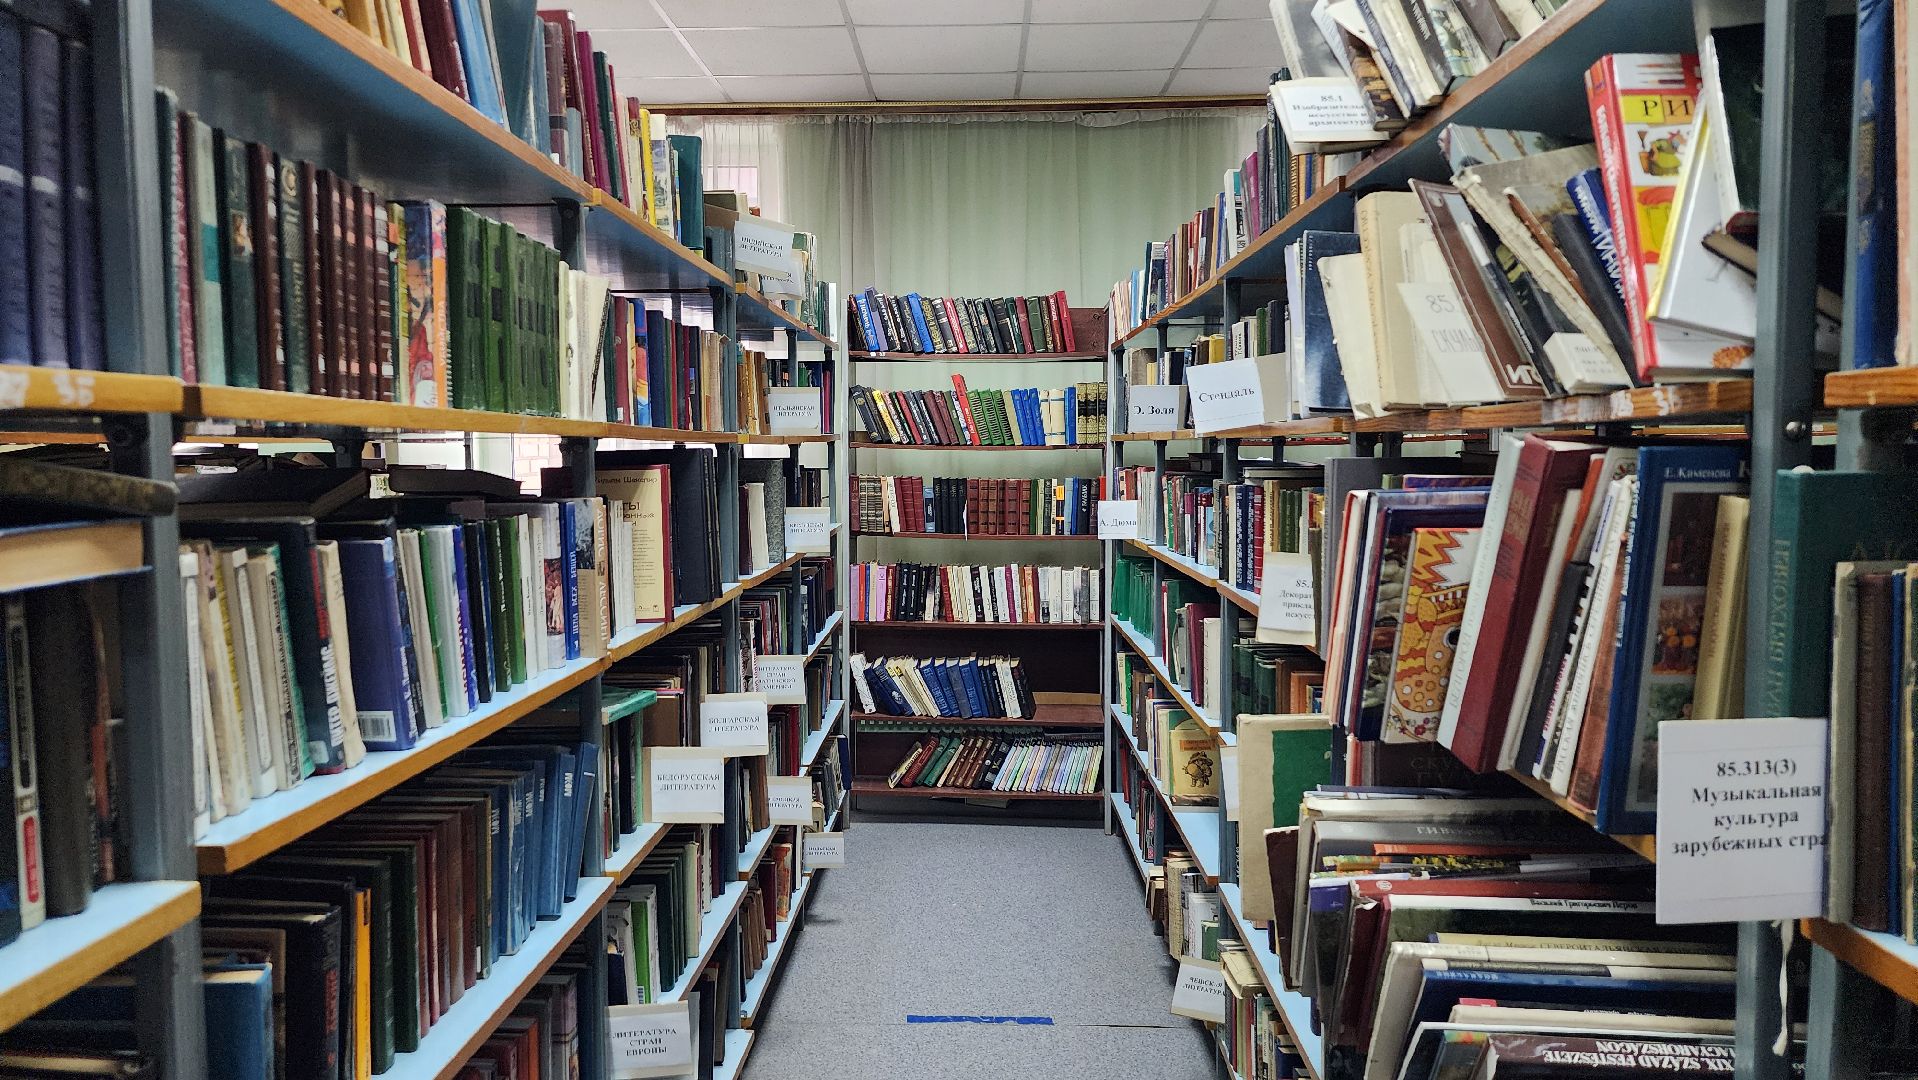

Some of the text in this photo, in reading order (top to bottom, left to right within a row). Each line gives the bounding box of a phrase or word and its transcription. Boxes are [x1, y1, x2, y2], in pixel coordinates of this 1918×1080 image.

[1198, 387, 1256, 403] Стендаль
[1147, 405, 1175, 415] Золя
[623, 476, 658, 484] Шекспир
[1100, 518, 1137, 528] А. Дюма
[320, 642, 338, 705] ДЖЕЙМС
[327, 705, 344, 747] ПИТЕР
[708, 716, 760, 725] БОЛГАРСКАЯ
[1715, 758, 1798, 778] 85.313(3)
[656, 774, 721, 782] БЕЛОРУССКАЯ
[660, 783, 717, 791] ЛИТЕРАТУРА
[1691, 785, 1823, 807] Музыкальная
[1713, 810, 1799, 831] культура
[1671, 836, 1783, 857] зарубежных
[611, 1028, 677, 1039] ЛИТЕРАТУРА
[629, 1038, 663, 1047] СТРАН
[626, 1046, 668, 1057] ЕВРОПЫ
